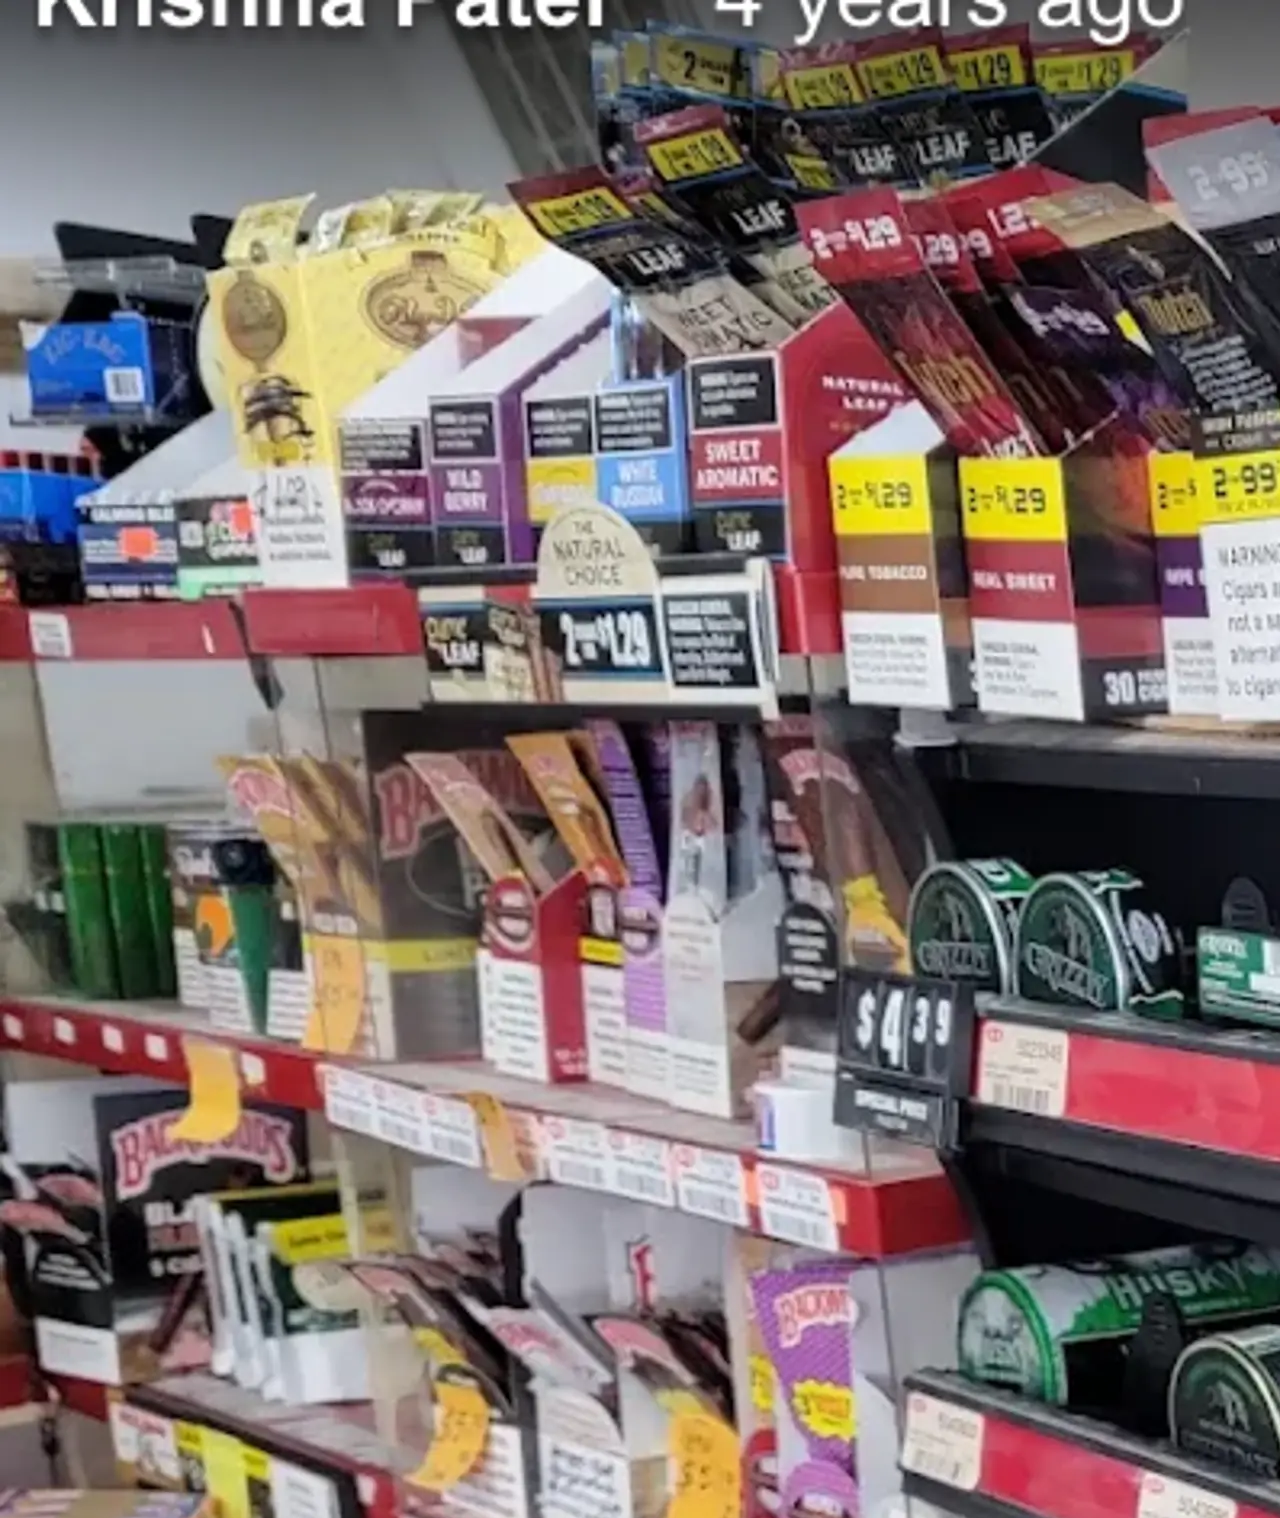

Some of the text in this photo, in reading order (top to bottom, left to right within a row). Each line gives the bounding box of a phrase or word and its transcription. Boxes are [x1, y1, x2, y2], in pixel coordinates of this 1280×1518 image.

[917, 134, 970, 164] LEAF
[738, 208, 786, 235] LEAF
[633, 248, 685, 276] LEAF
[705, 440, 762, 462] SWEET
[446, 469, 482, 489] WILD
[696, 464, 778, 490] AROMATIC
[443, 491, 488, 513] BERRY
[572, 521, 594, 536] THE
[553, 538, 626, 561] NATURAL
[564, 566, 623, 586] CHOICE
[868, 565, 928, 582] TOBACCO
[1222, 579, 1263, 602] Cigars
[1228, 612, 1251, 633] not
